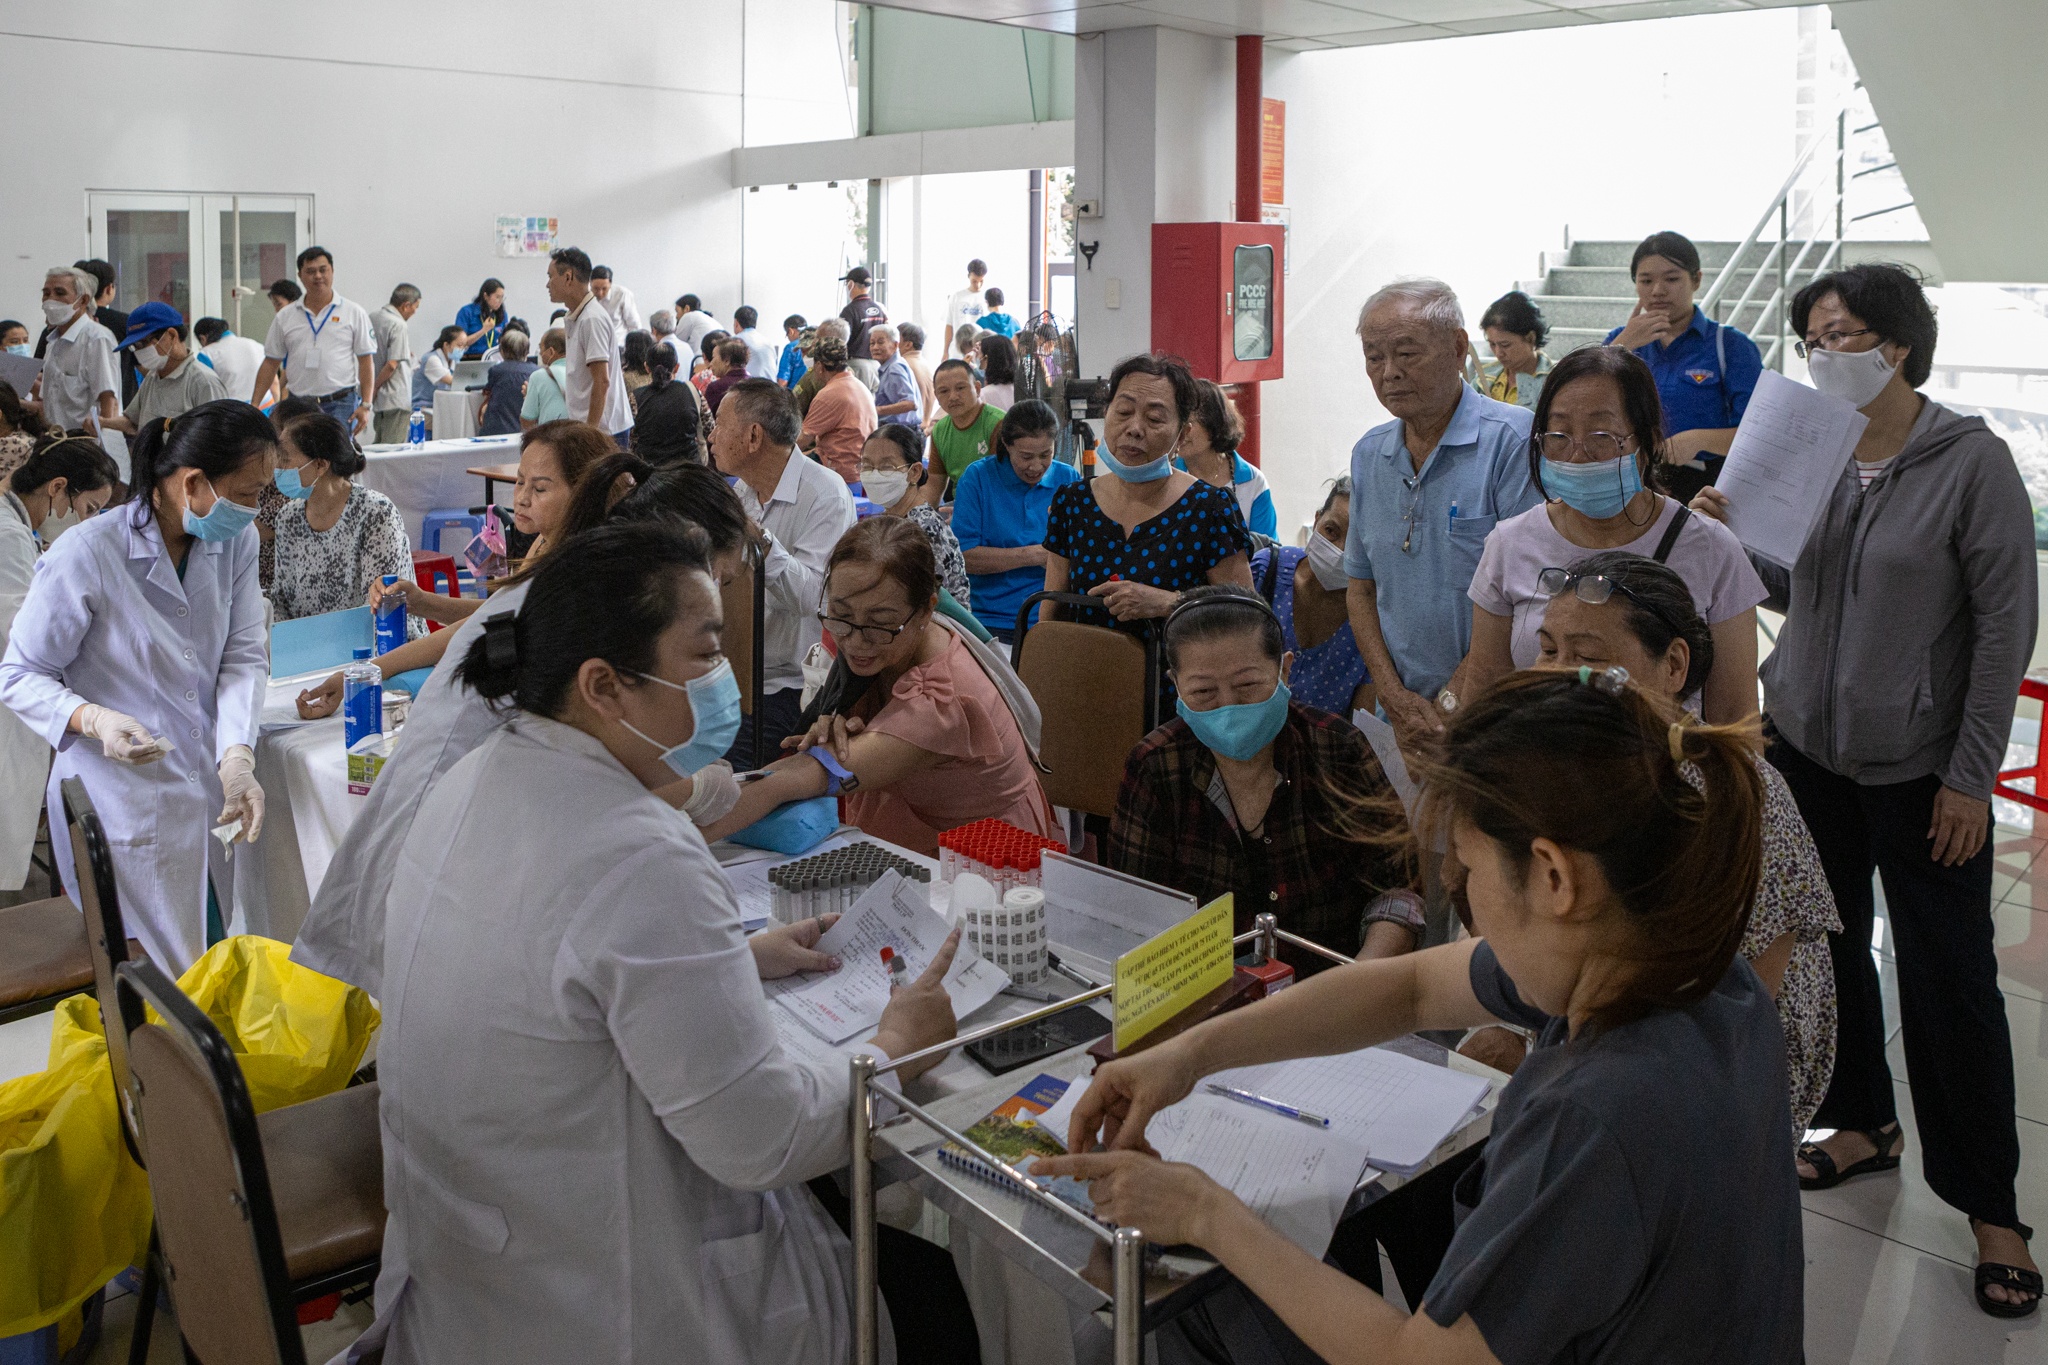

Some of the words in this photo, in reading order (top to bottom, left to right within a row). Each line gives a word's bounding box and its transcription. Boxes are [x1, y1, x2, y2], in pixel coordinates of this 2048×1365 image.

[1239, 284, 1266, 298] PCCC
[1142, 979, 1162, 997] TRUNG
[1183, 956, 1199, 971] HÀNH
[1216, 938, 1231, 950] CÔNG
